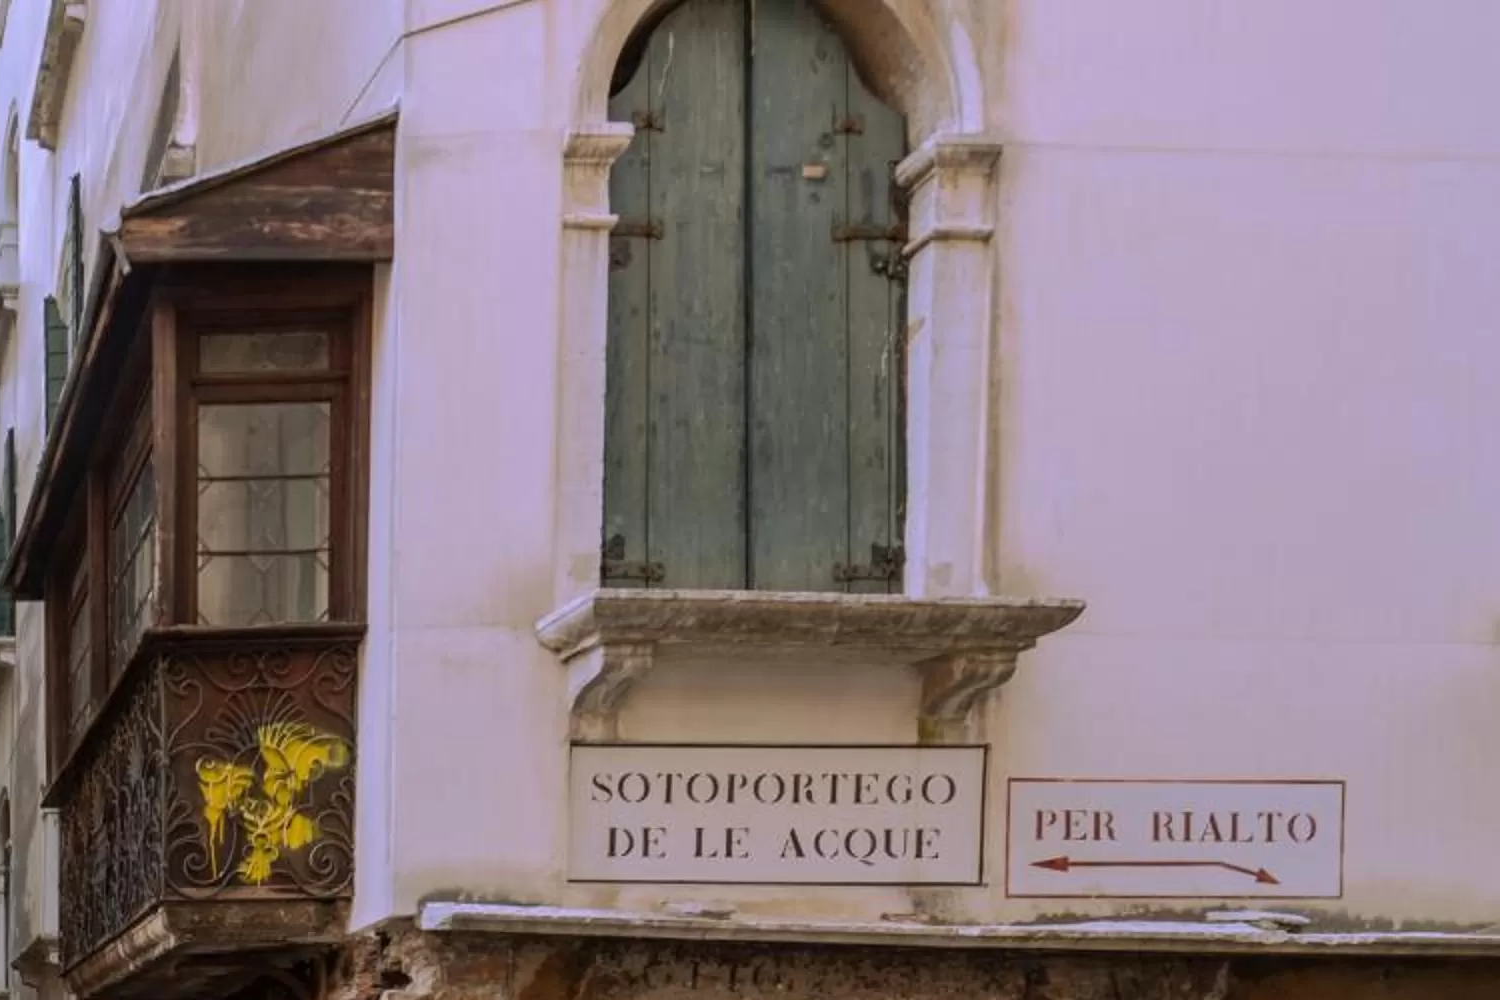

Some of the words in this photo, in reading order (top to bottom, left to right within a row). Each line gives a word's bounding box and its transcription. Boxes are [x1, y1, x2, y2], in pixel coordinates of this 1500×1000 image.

[591, 771, 957, 806] SOTOPORTEGO
[1034, 808, 1117, 843] PER
[1151, 809, 1319, 844] RIALTO
[606, 827, 667, 860] DE
[694, 827, 751, 860] LE
[780, 827, 941, 866] ACQUE
